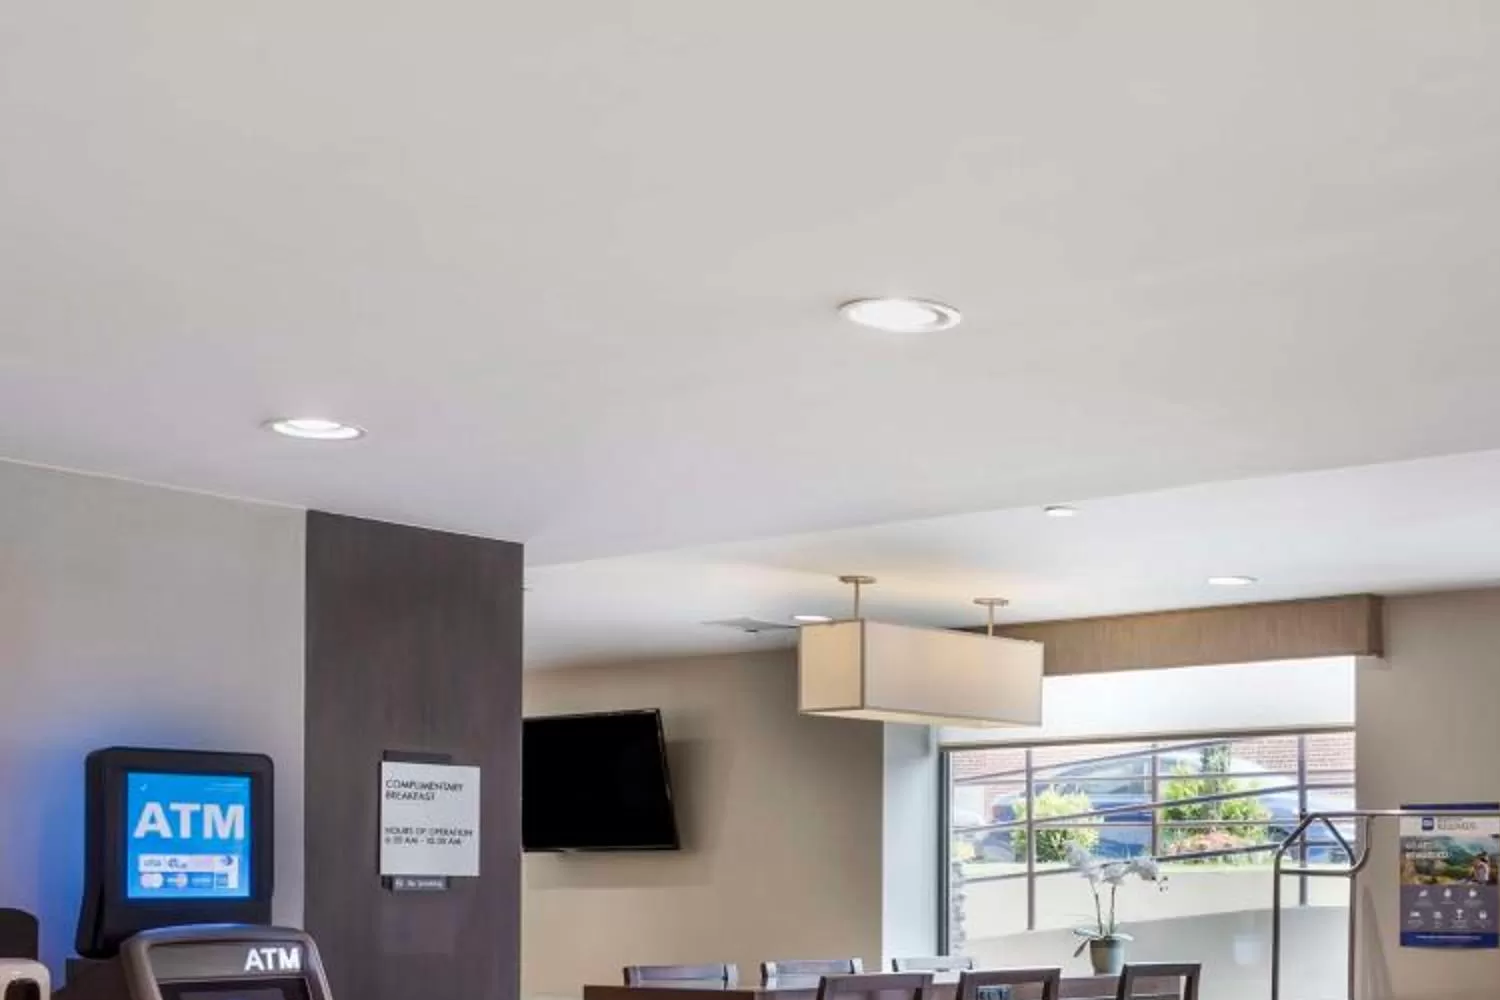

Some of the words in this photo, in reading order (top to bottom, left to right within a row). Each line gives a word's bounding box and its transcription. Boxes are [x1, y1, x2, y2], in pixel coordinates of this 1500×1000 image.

[385, 780, 464, 792] COMPLIMENTARY
[385, 791, 435, 800] BREAKFAST
[133, 801, 245, 839] ATM
[244, 947, 300, 971] ATM
